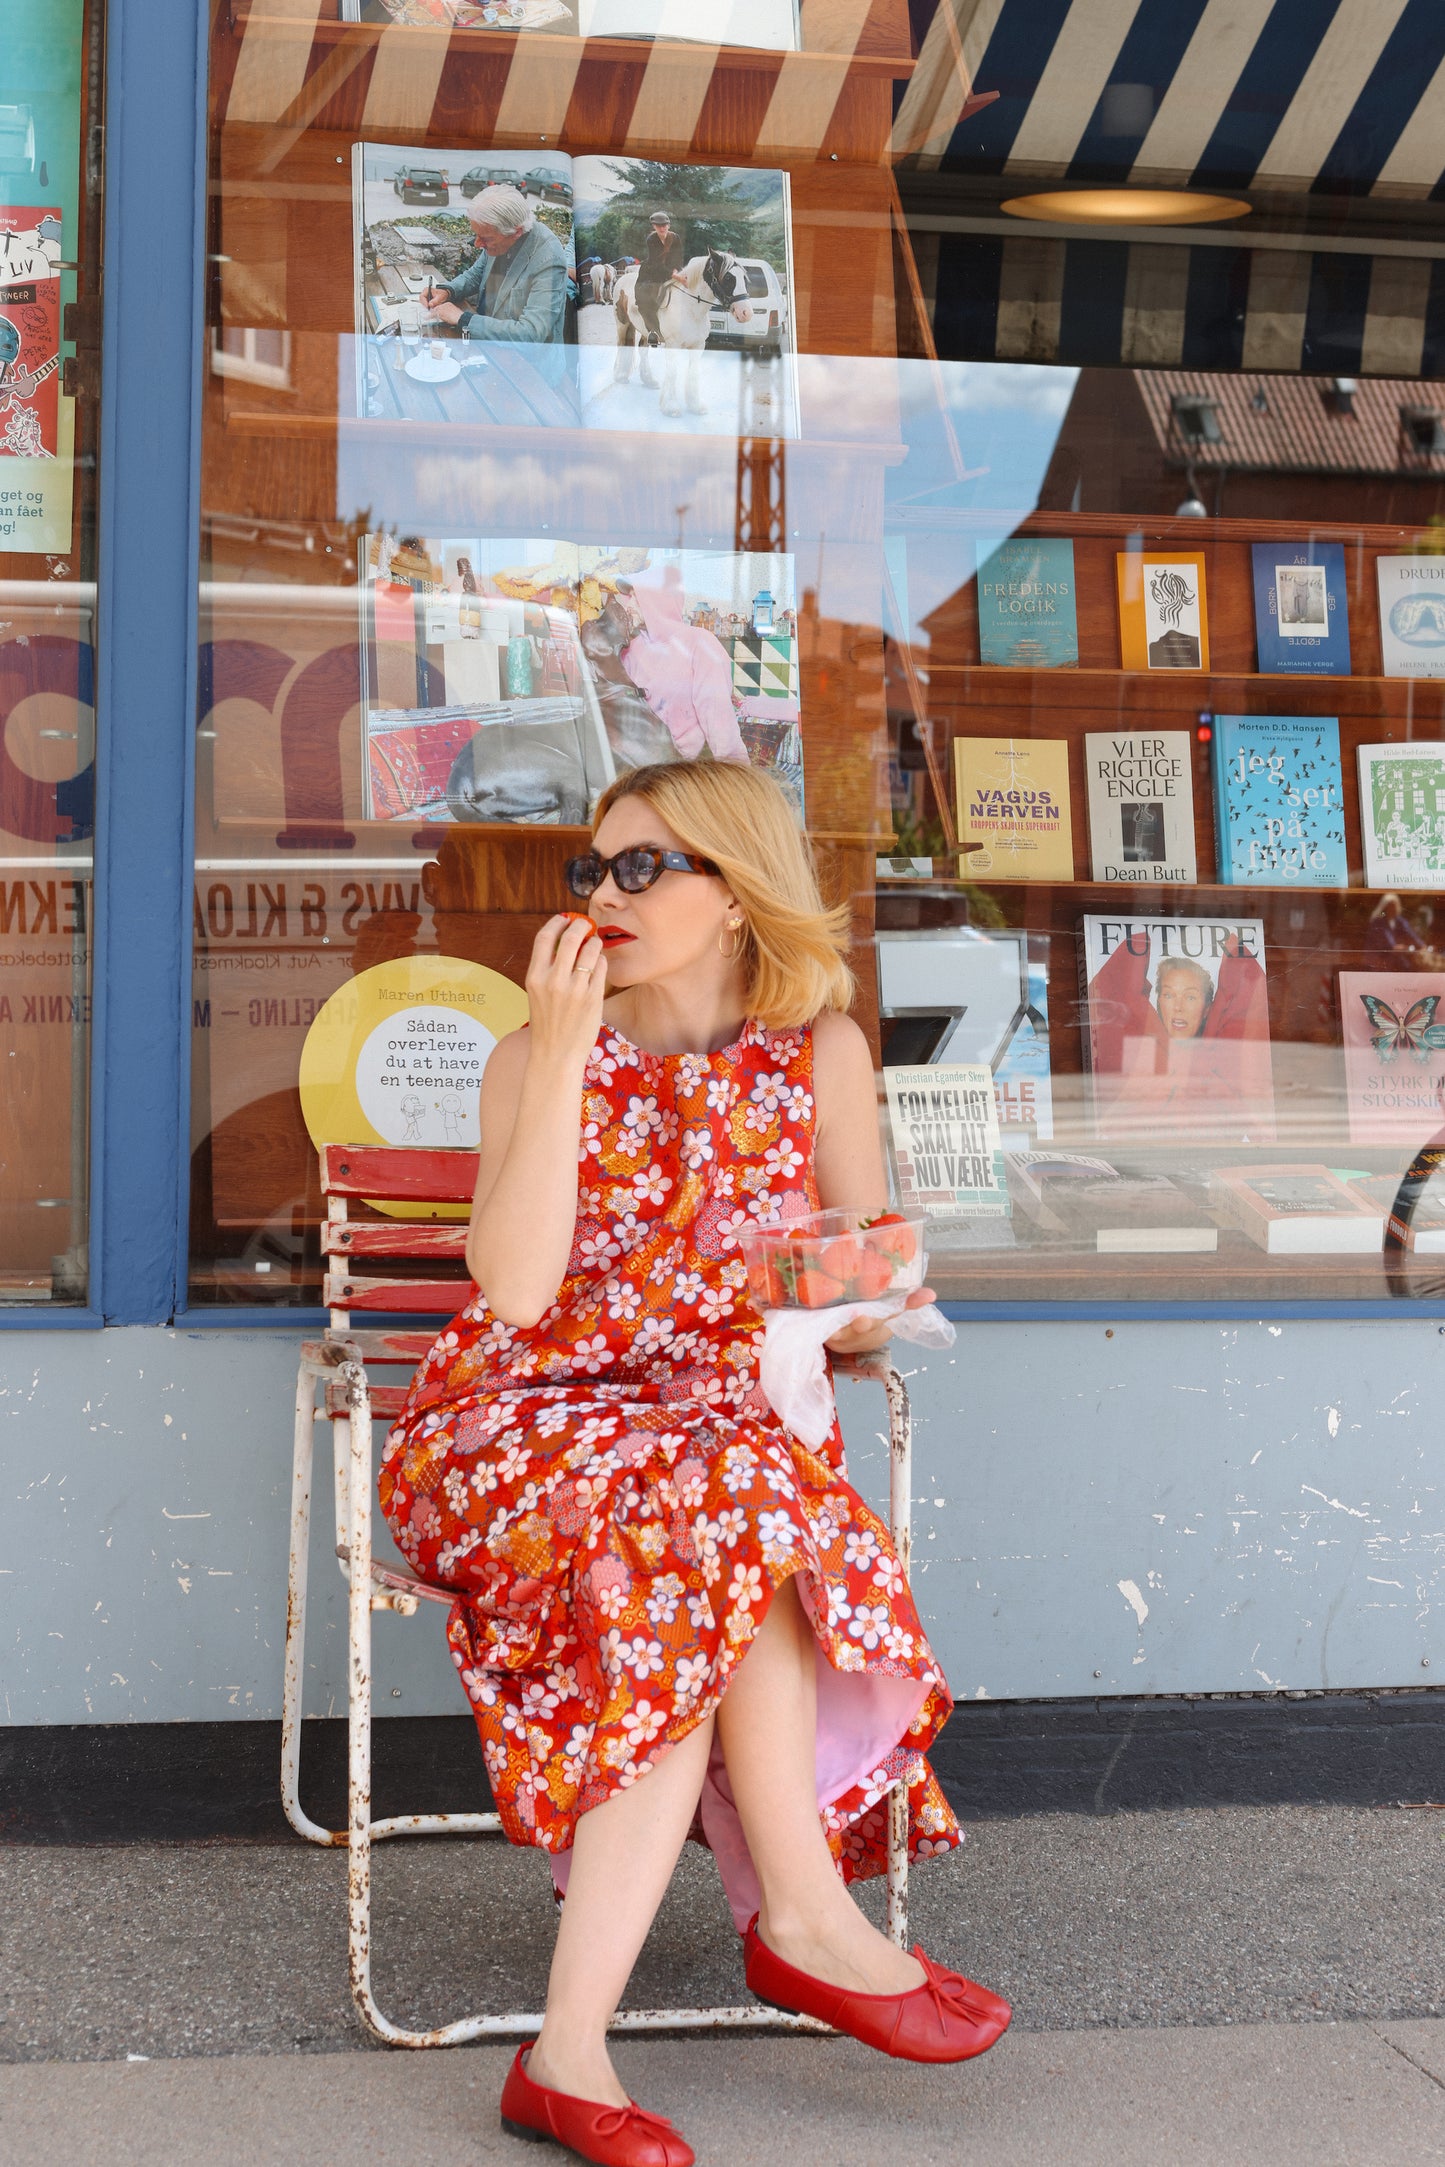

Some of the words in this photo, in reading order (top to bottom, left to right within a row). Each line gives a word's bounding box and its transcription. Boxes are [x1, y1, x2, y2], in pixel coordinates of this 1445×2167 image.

[10, 260, 33, 277] LIV
[26, 492, 44, 504] og
[17, 504, 44, 517] fået
[1293, 555, 1307, 565] ÅR
[983, 582, 1069, 596] FREDENS
[998, 600, 1056, 613] LOGIK
[1268, 587, 1277, 615] BØRN
[1327, 592, 1336, 612] JEG
[1288, 637, 1321, 646] FØDTE
[1238, 723, 1270, 731] Morten
[1272, 724, 1290, 732] D.D.
[1293, 724, 1326, 732] Hansen
[1112, 740, 1134, 758] VI
[1141, 739, 1166, 758] ER
[1098, 759, 1183, 778] RIGTIGE
[1234, 747, 1287, 785] jeg
[976, 789, 1052, 804] VAGUS
[1107, 779, 1176, 797] ENGLE
[1286, 787, 1336, 807] ser
[970, 803, 1060, 819] NERVEN
[970, 820, 999, 830] KROPPENS
[1000, 820, 1024, 831] SKJULTE
[1025, 821, 1060, 832] SUPERKRAFT
[1265, 810, 1304, 846] på
[1248, 840, 1327, 879] fugle
[1105, 866, 1148, 881] Dean
[1153, 865, 1188, 881] Butt
[1099, 922, 1260, 959] FUTURE
[378, 988, 425, 1001] Maren
[429, 990, 487, 1005] Uthaug
[407, 1019, 458, 1034] Sådan
[387, 1038, 478, 1052] overlever
[385, 1055, 407, 1069] du
[412, 1058, 433, 1070] at
[439, 1056, 480, 1070] have
[380, 1075, 400, 1087] en
[405, 1074, 482, 1091] teenager
[895, 1072, 933, 1084] Christian
[935, 1071, 967, 1085] Egander
[968, 1071, 986, 1084] Skov
[1367, 1075, 1422, 1092] STYRK
[897, 1089, 990, 1123] FOLKELIGT
[909, 1122, 957, 1156] SKAL
[960, 1122, 987, 1155] ALT
[913, 1156, 942, 1188] NU
[943, 1155, 994, 1188] VÆRE
